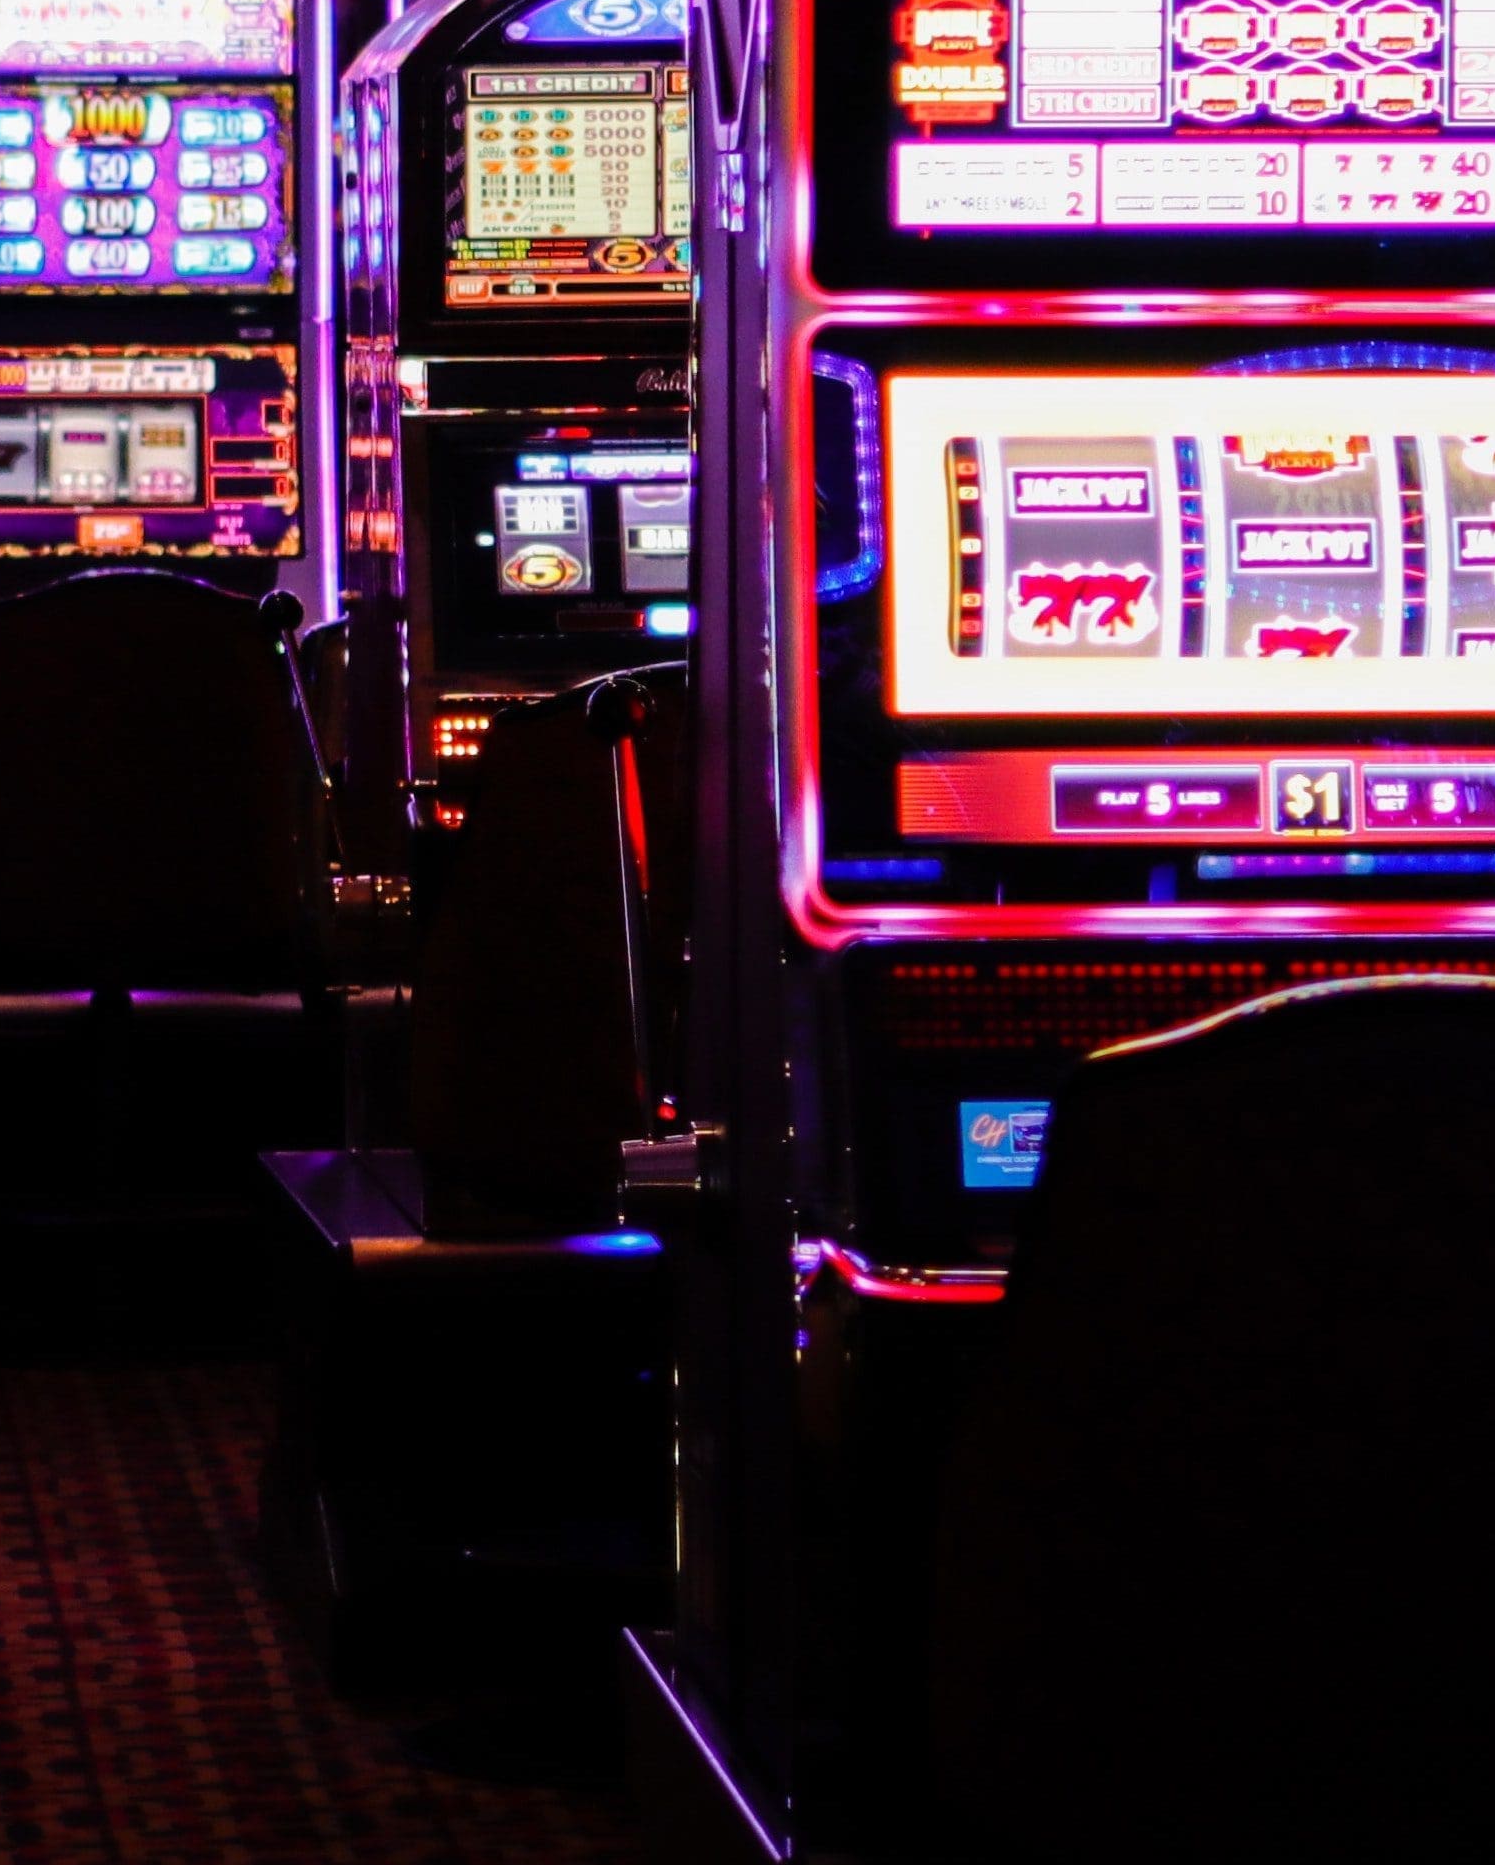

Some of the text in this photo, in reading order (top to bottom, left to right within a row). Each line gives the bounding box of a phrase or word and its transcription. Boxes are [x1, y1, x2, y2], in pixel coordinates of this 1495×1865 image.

[489, 74, 637, 93] 1st CREDIT
[900, 67, 1005, 90] DOUBLES
[70, 93, 147, 136] 1000
[583, 109, 646, 122] 5000
[1028, 92, 1073, 114] 5TH
[1076, 92, 1156, 114] CREDIT
[583, 126, 646, 140] 5000
[583, 143, 646, 158] 5000
[88, 155, 129, 184] 50
[211, 158, 244, 183] 25
[1066, 153, 1085, 178] 5
[1255, 152, 1288, 178] 20
[1451, 151, 1490, 177] 40
[85, 197, 134, 228] 100
[213, 199, 243, 225] 15
[1065, 191, 1084, 217] 2
[1255, 190, 1288, 216] 10
[1452, 189, 1490, 215] 20
[91, 240, 127, 268] 40
[607, 246, 643, 267] 5
[1270, 453, 1337, 470] JACKPOT
[1017, 476, 1147, 507] JACKPOT
[1241, 530, 1370, 560] JACKPOT
[523, 556, 566, 588] 5
[1099, 791, 1139, 805] PLAY
[1146, 785, 1171, 816] 5
[1285, 772, 1342, 821] $1
[1431, 781, 1456, 813] 5
